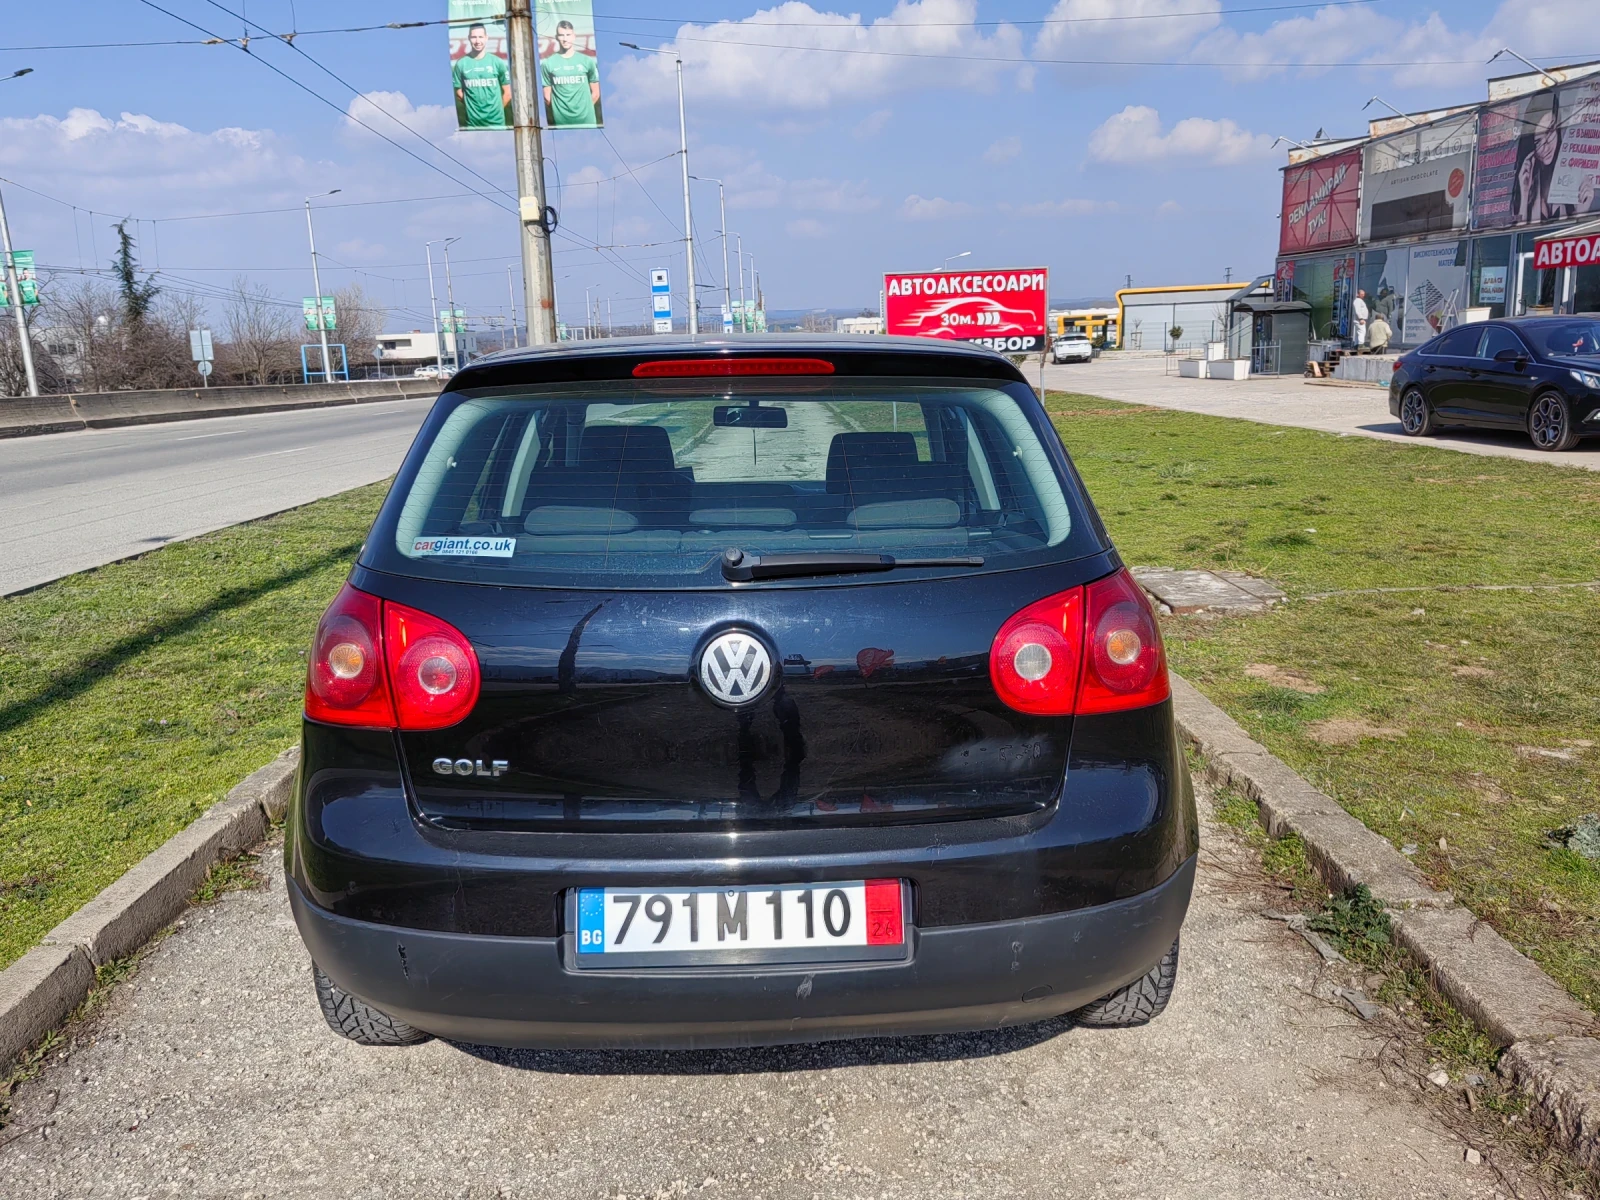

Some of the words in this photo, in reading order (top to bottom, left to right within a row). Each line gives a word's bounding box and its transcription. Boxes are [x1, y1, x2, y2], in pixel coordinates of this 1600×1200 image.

[464, 78, 498, 88] WINBET
[552, 75, 586, 85] WINBET
[1390, 177, 1410, 186] ARTISAN
[1411, 169, 1439, 181] CHOCOLATE
[888, 273, 1044, 296] АВТОАКСЕСОАРИ
[414, 537, 512, 551] cargiant.co.uk
[432, 757, 509, 777] GOLF
[581, 929, 602, 945] BG
